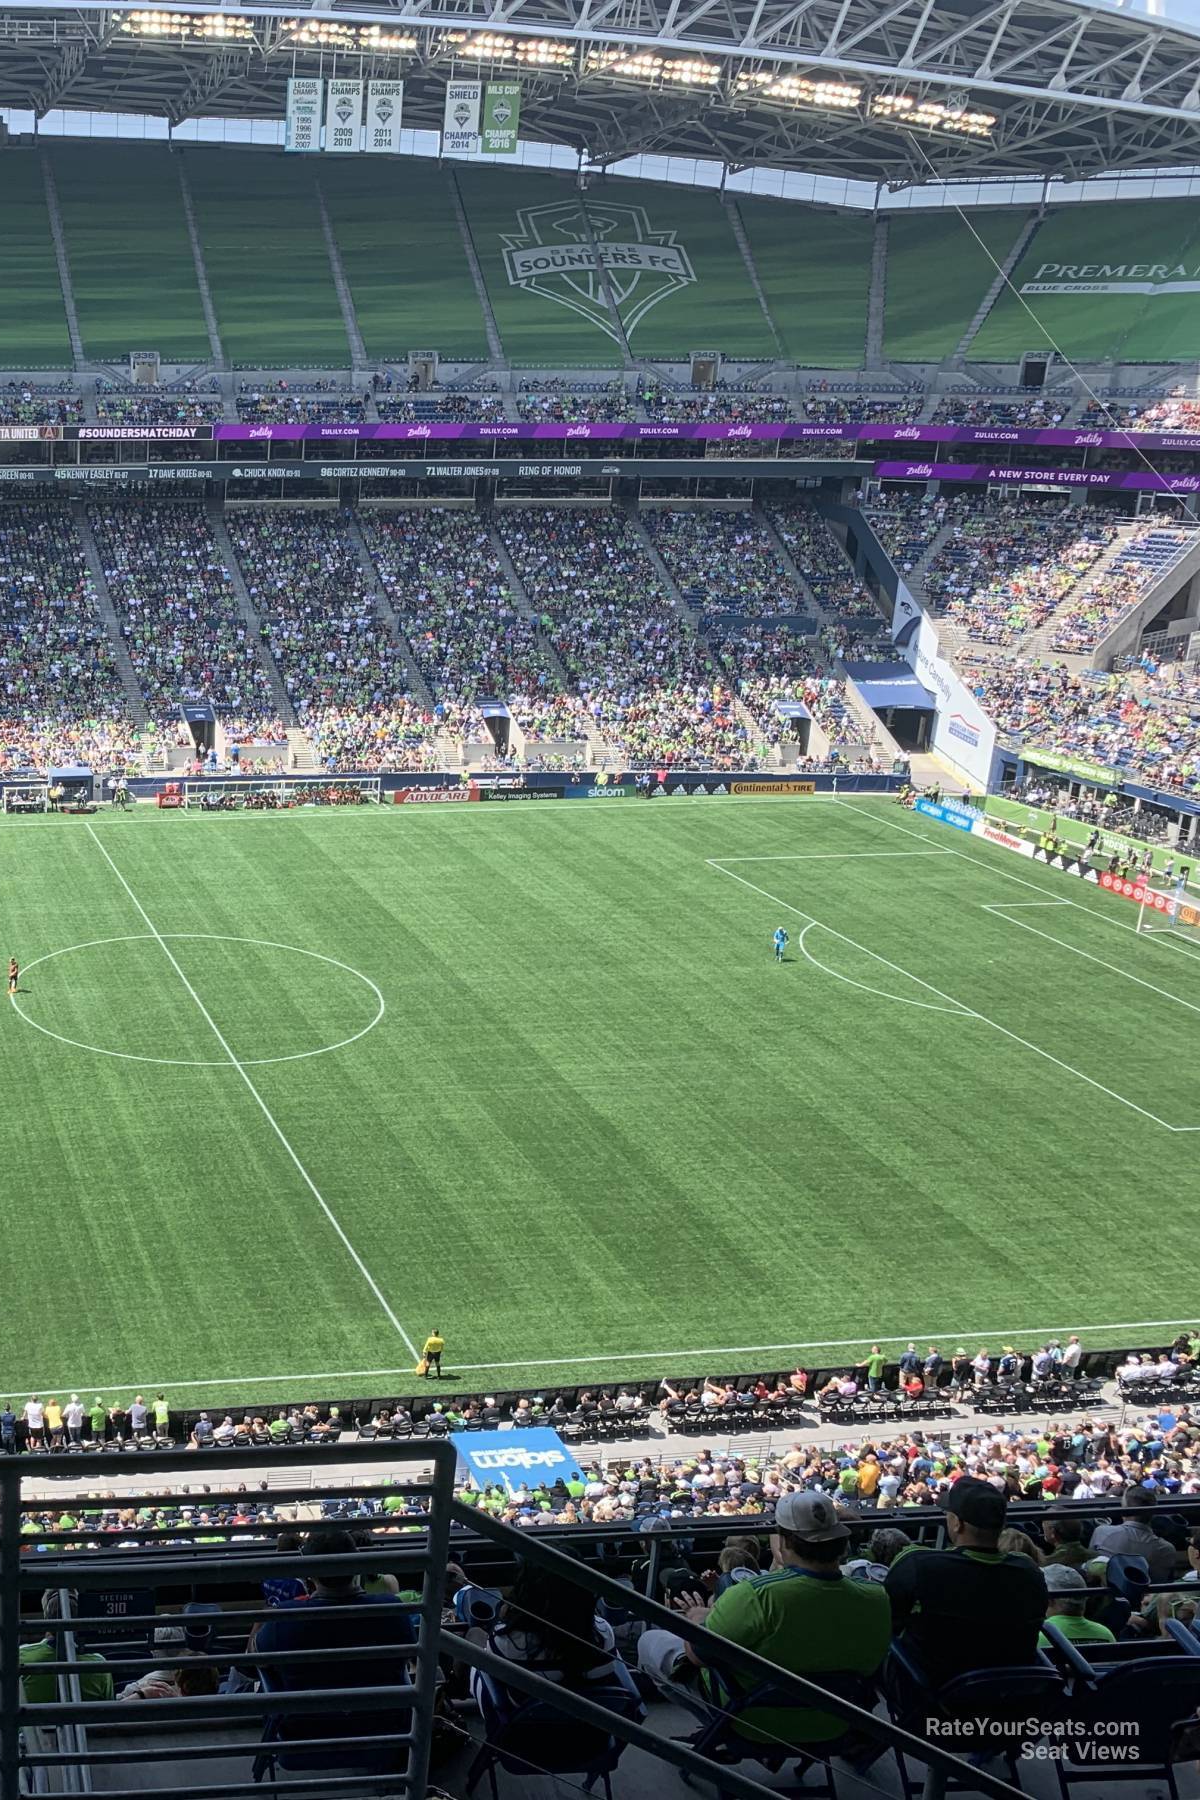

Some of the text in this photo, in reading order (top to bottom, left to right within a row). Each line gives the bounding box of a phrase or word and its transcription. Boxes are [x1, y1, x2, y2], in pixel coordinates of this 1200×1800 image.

[331, 87, 360, 96] CHAMPS
[371, 88, 400, 96] CHAMPS
[487, 85, 520, 94] MLS CUP
[449, 91, 479, 100] SHIELD
[334, 128, 353, 137] 2009
[374, 129, 392, 137] 2011
[445, 131, 478, 140] CHAMPS
[485, 130, 516, 138] CHAMPS
[334, 138, 352, 147] 2010
[374, 138, 392, 147] 2014
[451, 141, 469, 149] 2014
[648, 254, 680, 271] FC
[1034, 263, 1187, 280] PREMERA
[1026, 284, 1110, 292] BLUE CROSS
[11, 428, 39, 439] UNITED
[78, 428, 197, 438] #SOUNDERSMATCHDAY
[55, 470, 114, 479] 45 KENNY EASLEY
[149, 469, 197, 478] 17 DAVE KRIEG
[244, 468, 286, 477] CHUCK KNOX
[320, 468, 390, 477] 96 CORTEZ KENNEDY
[426, 467, 484, 476] 71 WALTER JONES
[519, 466, 581, 475] RING OF HONOR
[999, 470, 1022, 478] NEW
[1024, 471, 1055, 480] STORE
[1058, 473, 1088, 482] EVERY
[1089, 474, 1110, 483] DAY
[588, 786, 625, 797] slalom
[734, 783, 812, 794] Continental TIRE
[404, 790, 470, 802] ADVOCARE
[532, 791, 557, 799] Systems
[107, 1602, 127, 1614] 310
